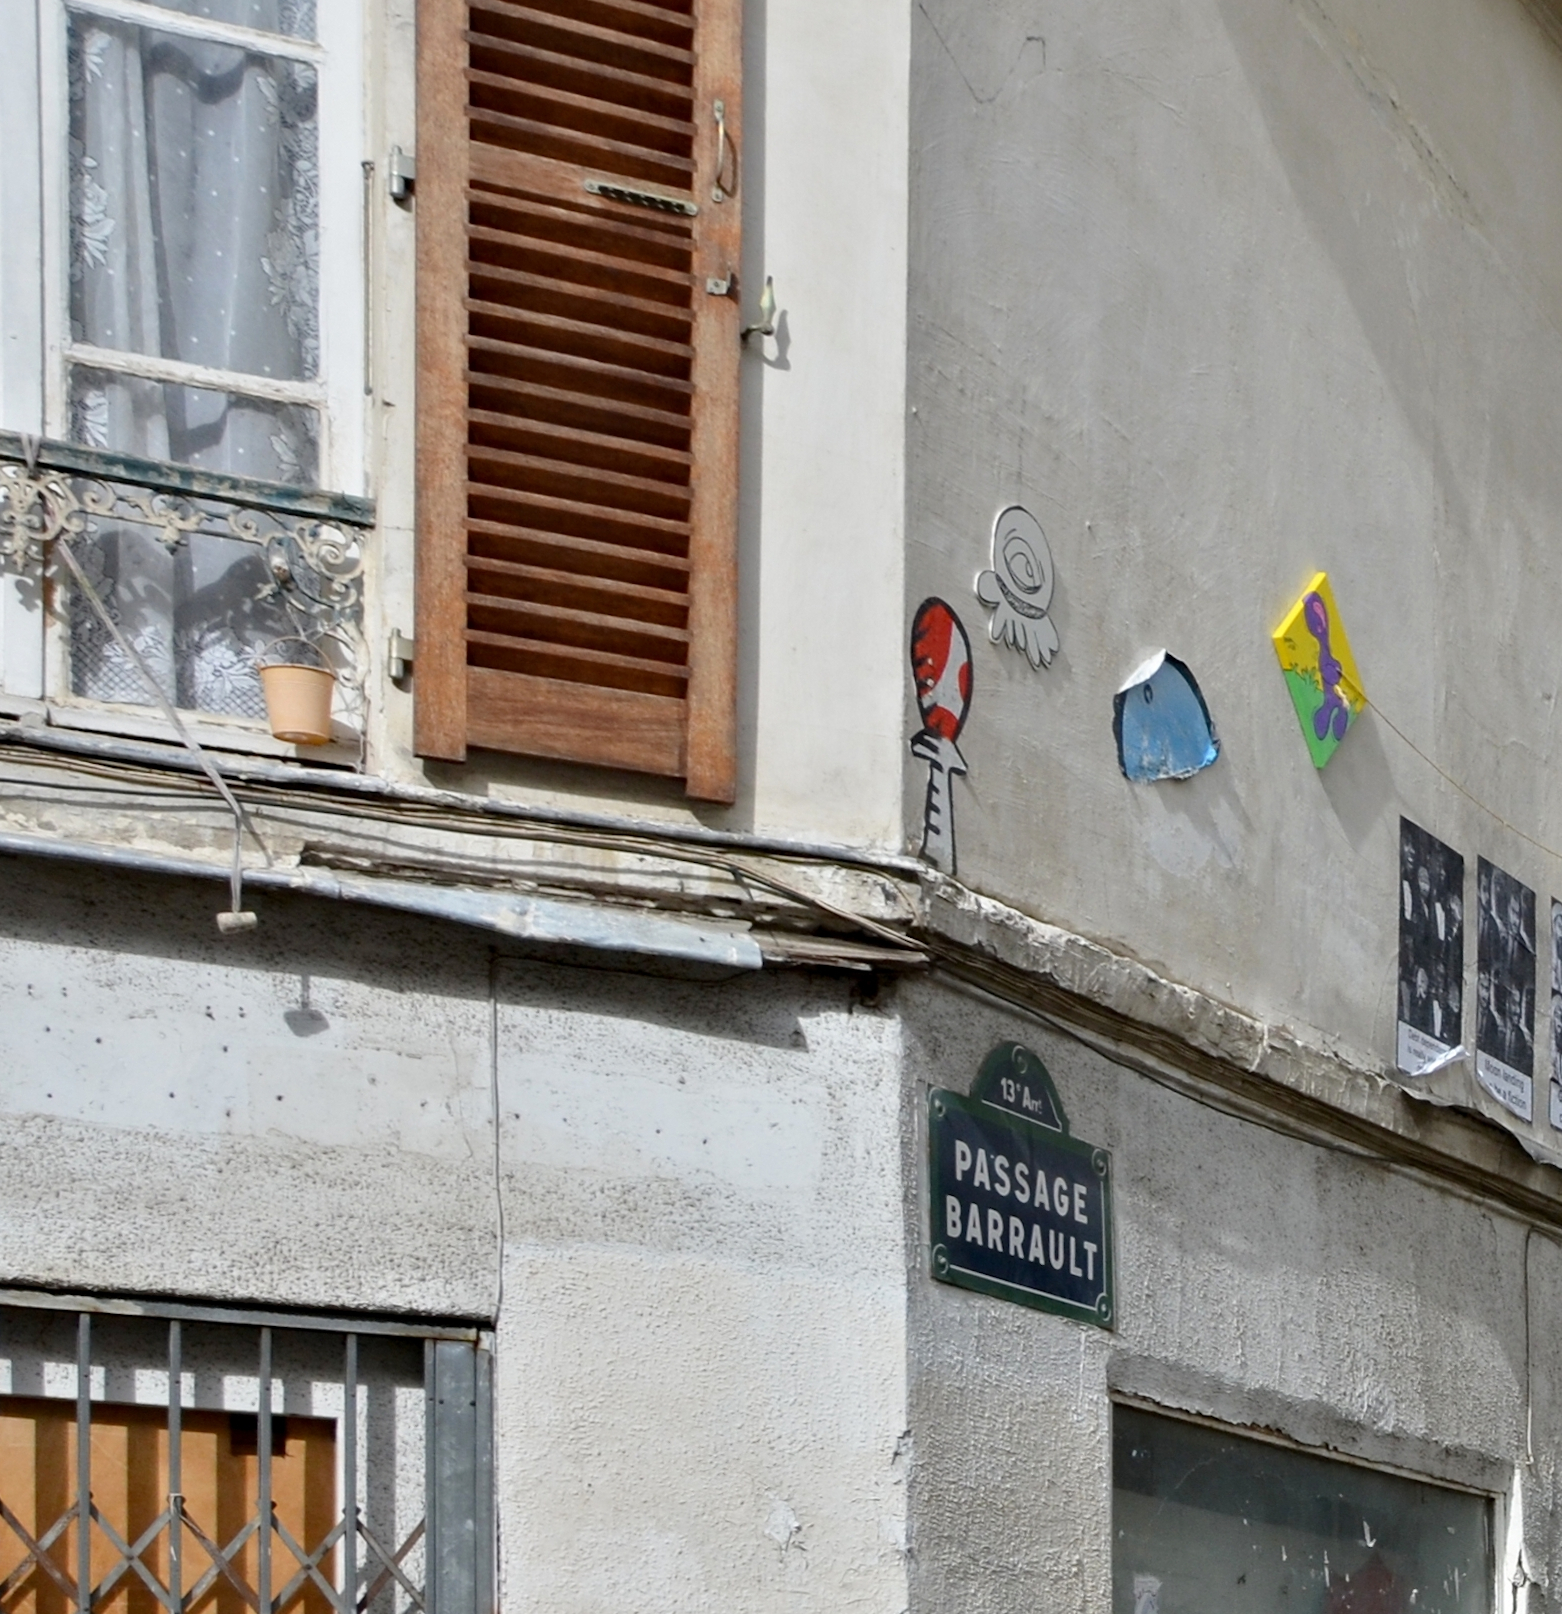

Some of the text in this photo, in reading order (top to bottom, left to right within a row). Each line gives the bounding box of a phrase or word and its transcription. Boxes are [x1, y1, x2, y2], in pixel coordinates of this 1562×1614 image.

[1502, 1068, 1524, 1094] landing
[1508, 1090, 1527, 1110] fiction
[954, 1139, 1089, 1226] PASSAGE
[945, 1194, 1099, 1281] BARRAULT
